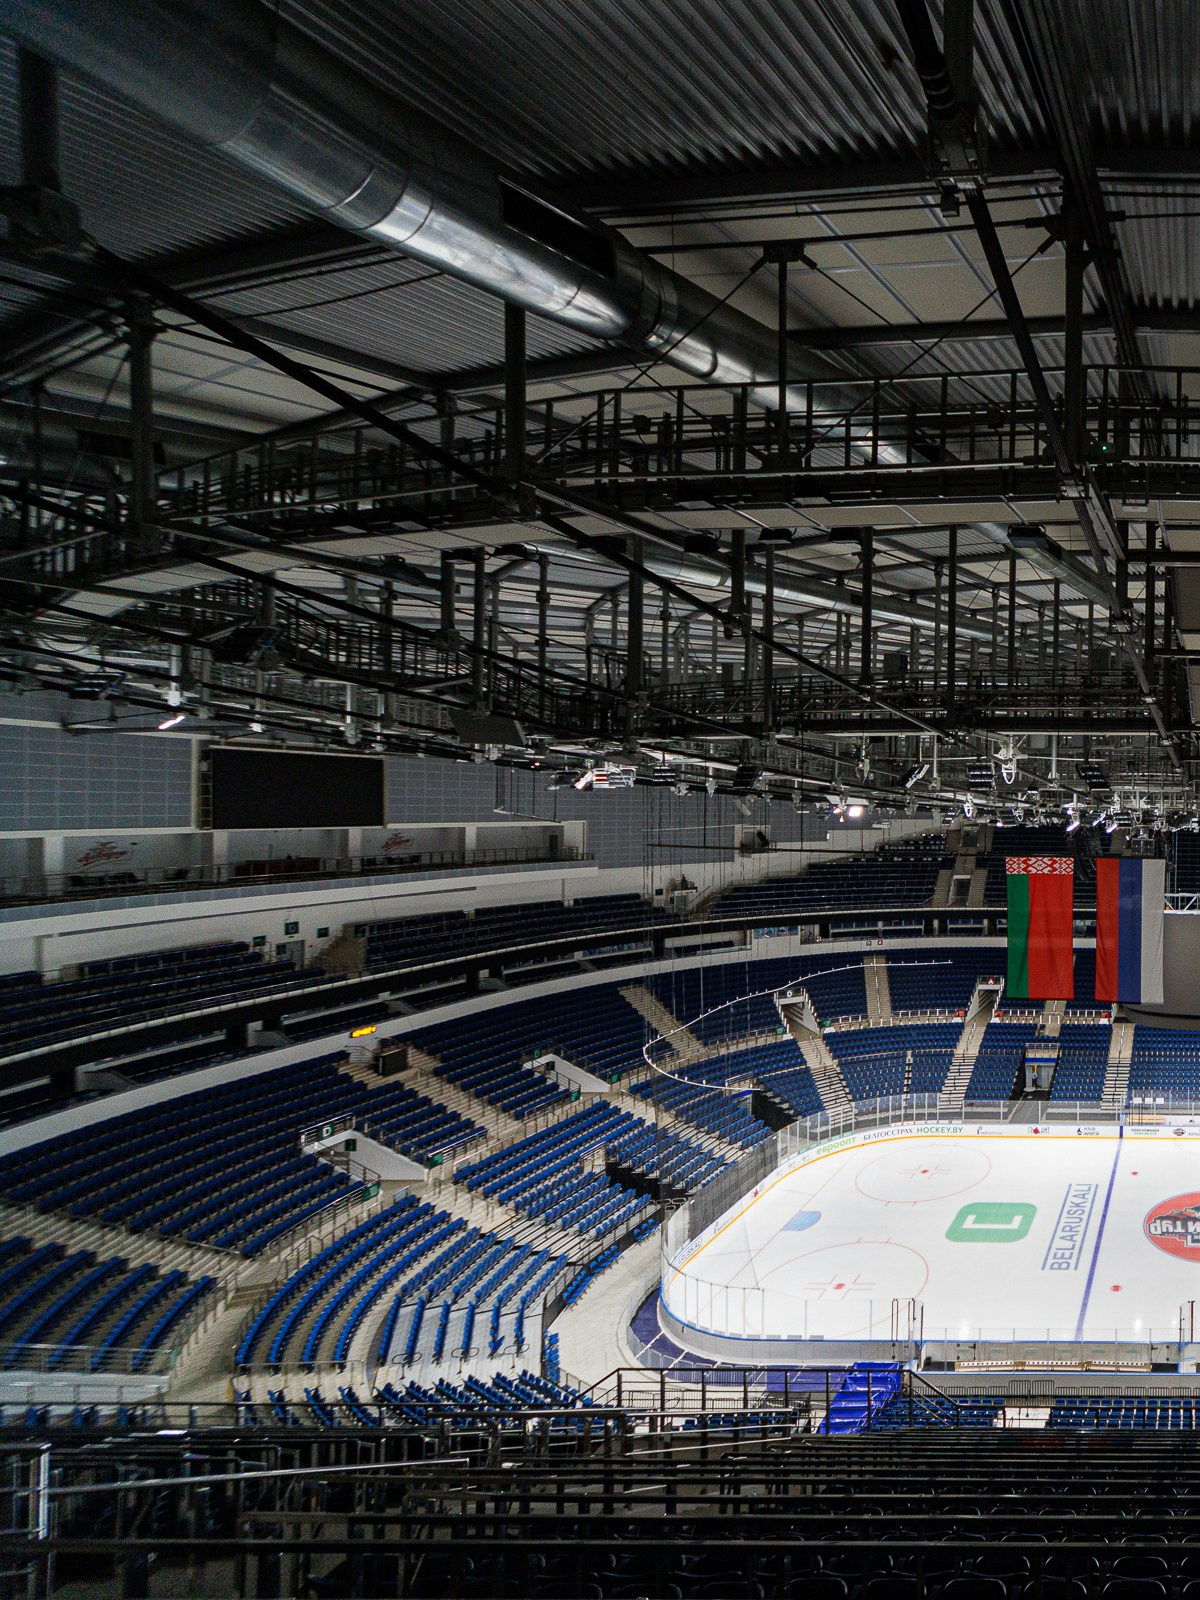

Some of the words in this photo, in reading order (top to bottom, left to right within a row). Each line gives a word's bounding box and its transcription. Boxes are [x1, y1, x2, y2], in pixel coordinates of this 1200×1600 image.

[322, 1126, 332, 1138] D
[863, 1126, 914, 1141] БЕЛГОССТРАХ
[916, 1126, 964, 1134] HOCKEY.BY
[1048, 1183, 1092, 1271] BELARUSKALI
